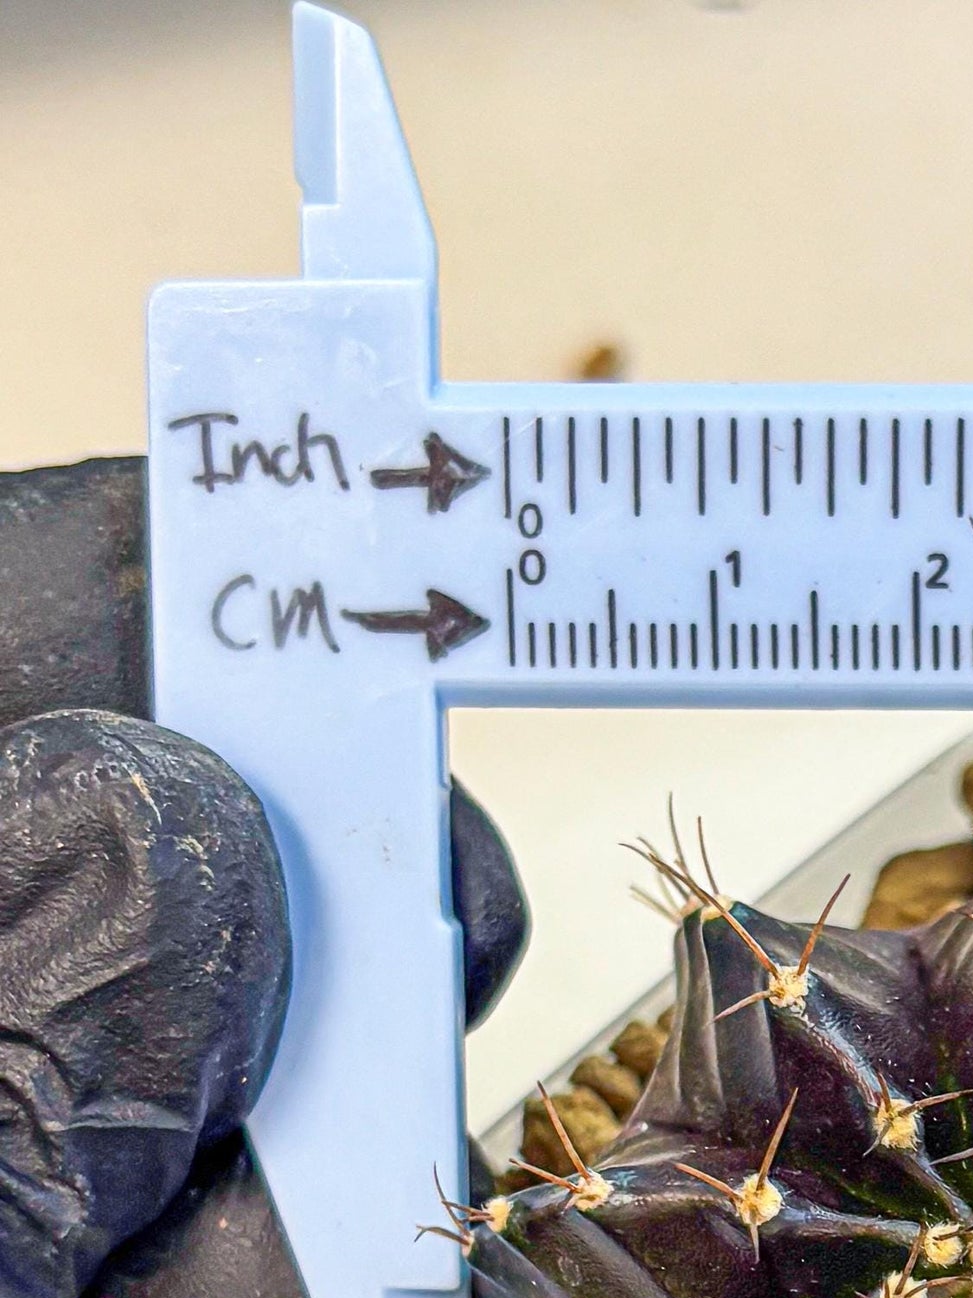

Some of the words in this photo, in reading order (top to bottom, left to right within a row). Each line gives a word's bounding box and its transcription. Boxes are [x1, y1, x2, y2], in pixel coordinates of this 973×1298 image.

[167, 411, 352, 494] Inch
[517, 502, 544, 540] 0
[517, 548, 547, 586] 0
[724, 549, 742, 588] 1
[924, 552, 950, 590] 2
